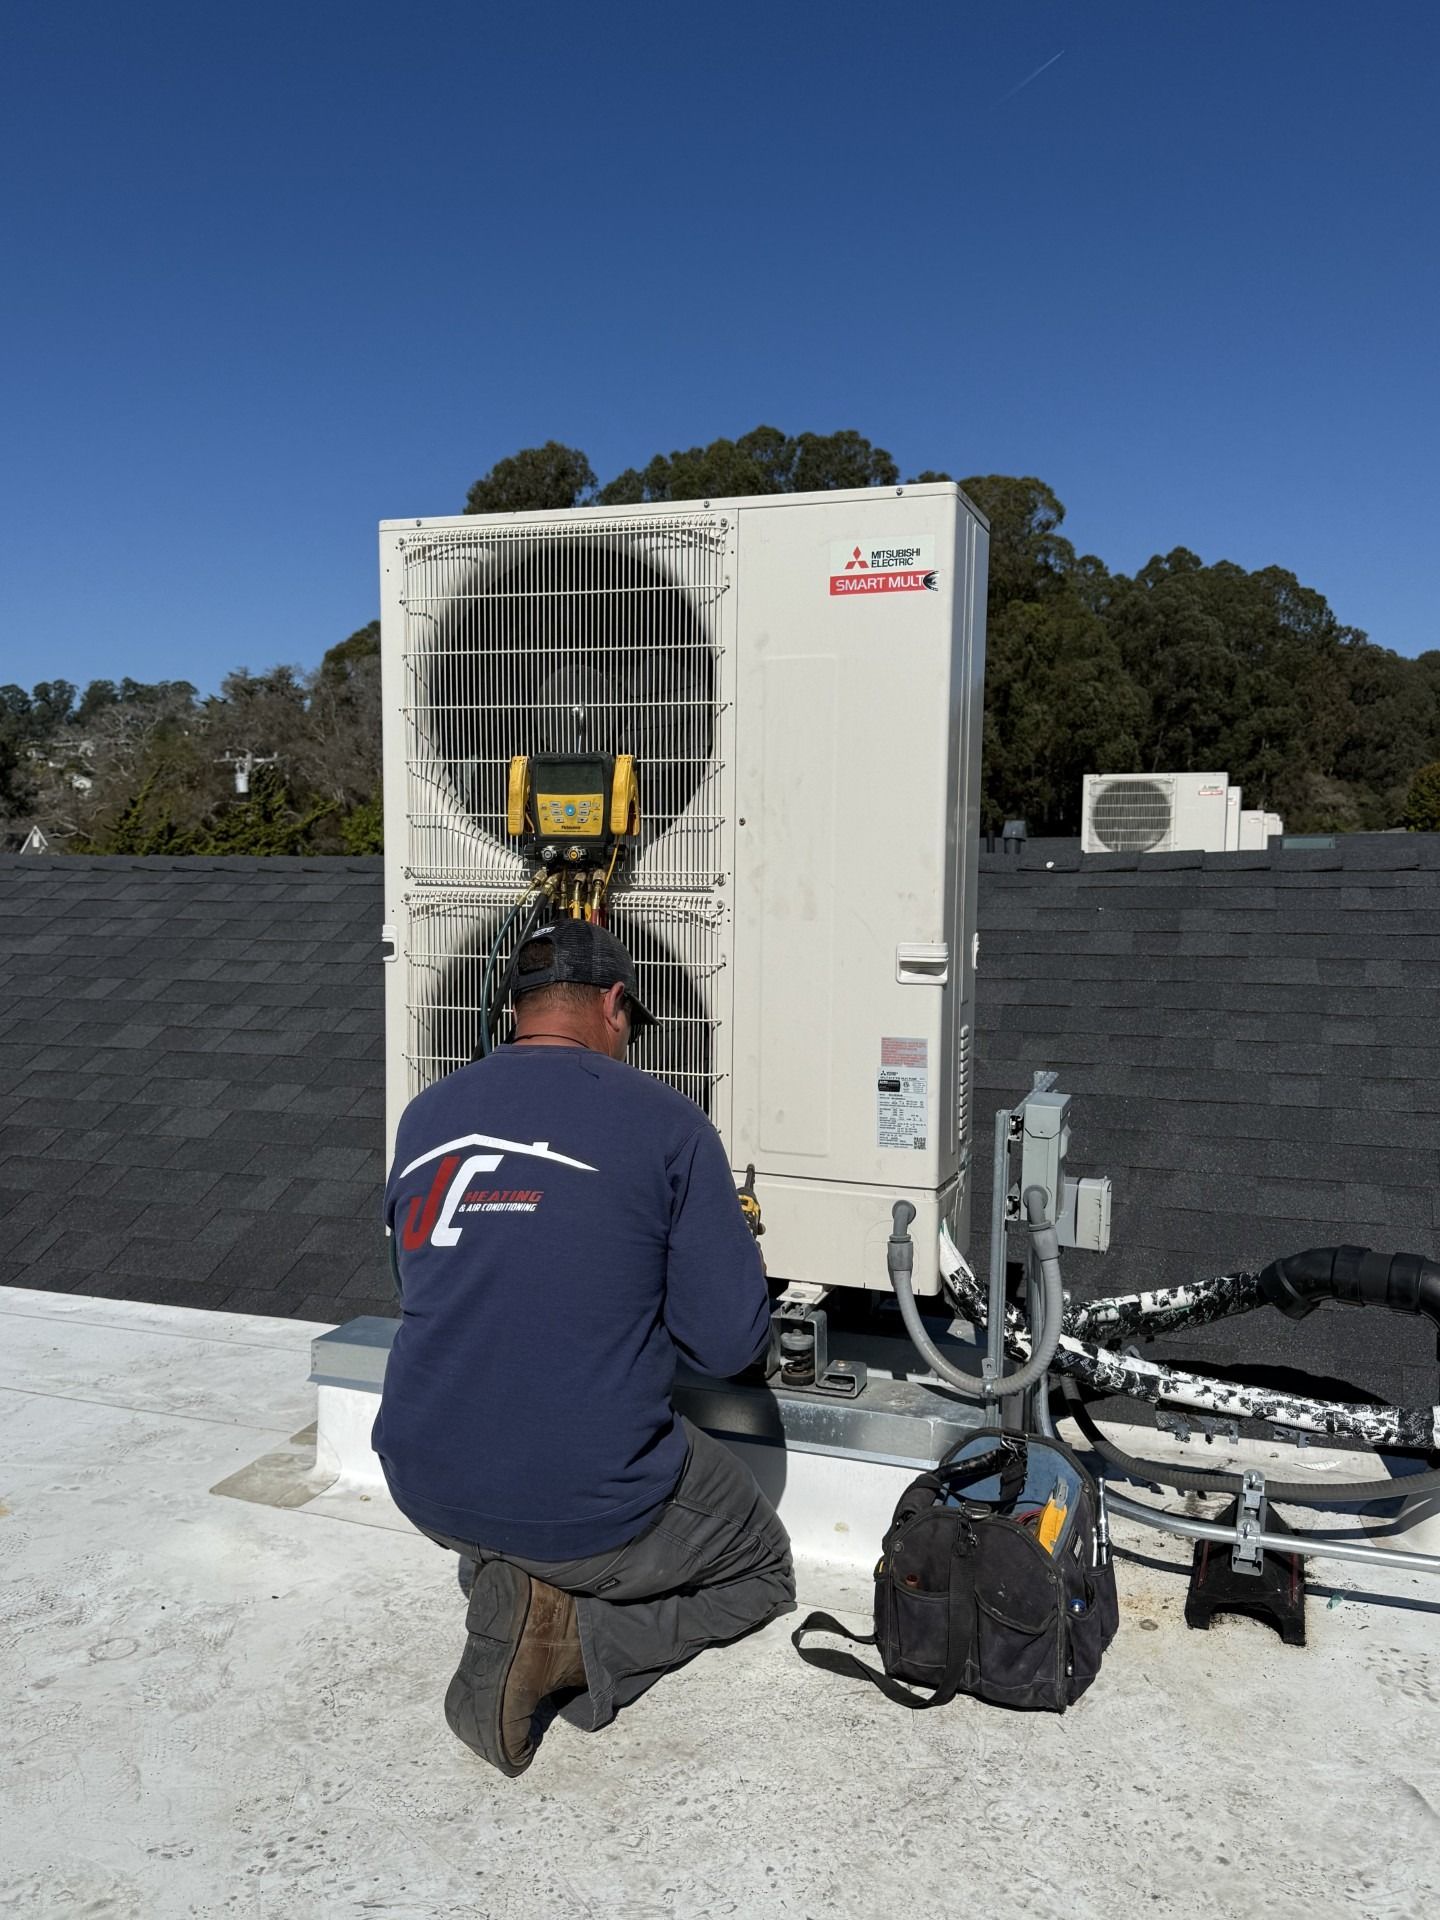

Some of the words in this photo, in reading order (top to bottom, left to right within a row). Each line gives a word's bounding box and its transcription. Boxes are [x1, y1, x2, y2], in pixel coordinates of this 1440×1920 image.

[871, 548, 921, 559] MITSUBISHI
[871, 557, 914, 568] ELECTRIC
[835, 577, 886, 591] SMART
[464, 1190, 544, 1202] HEATING
[458, 1204, 466, 1213] &
[466, 1203, 482, 1212] AIR
[481, 1202, 537, 1212] CONDITIONING
